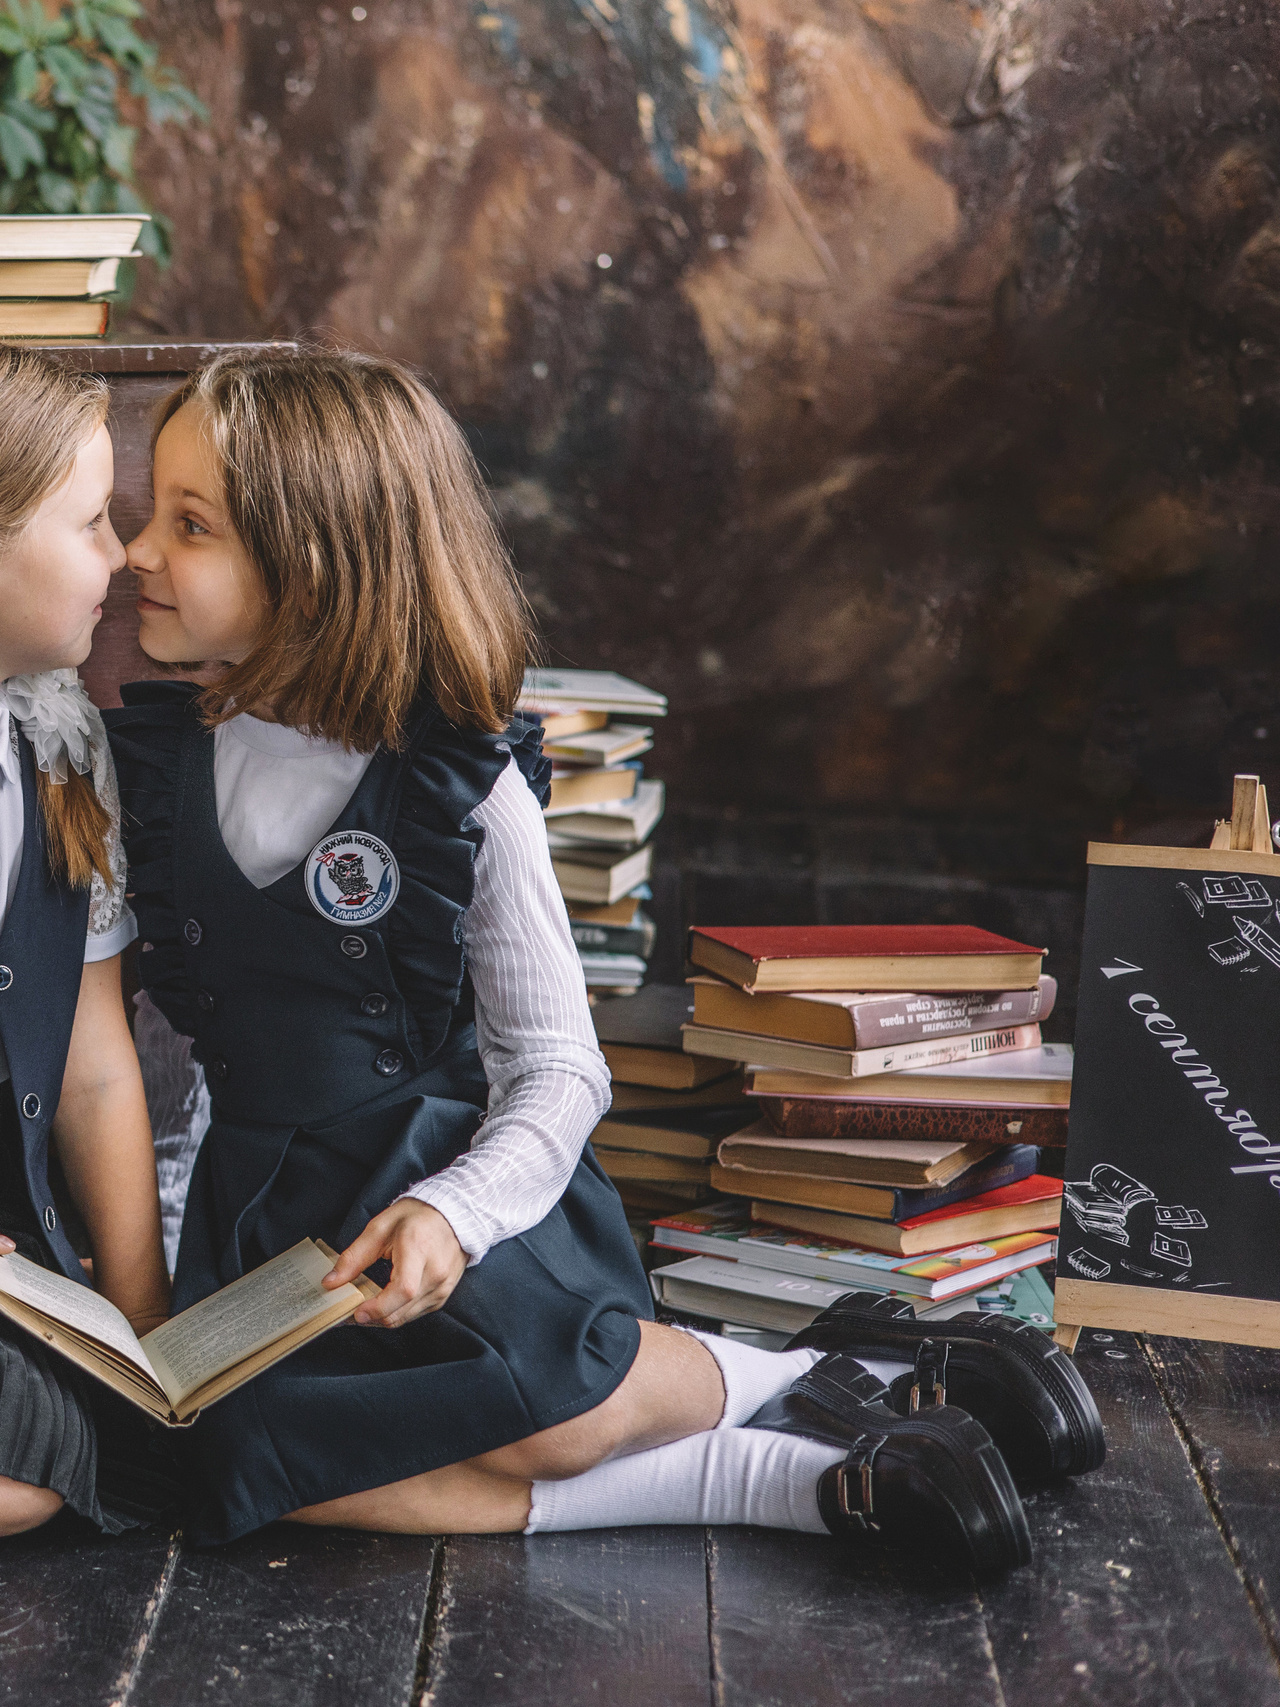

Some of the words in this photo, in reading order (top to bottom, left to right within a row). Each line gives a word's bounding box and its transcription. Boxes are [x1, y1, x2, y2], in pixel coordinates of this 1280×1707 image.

[319, 834, 353, 855] НИЖНИЙ
[354, 836, 391, 866] НОВГОРОД
[330, 905, 376, 920] ГИМНАЗИЯ
[971, 1031, 1016, 1053] ШПИОН
